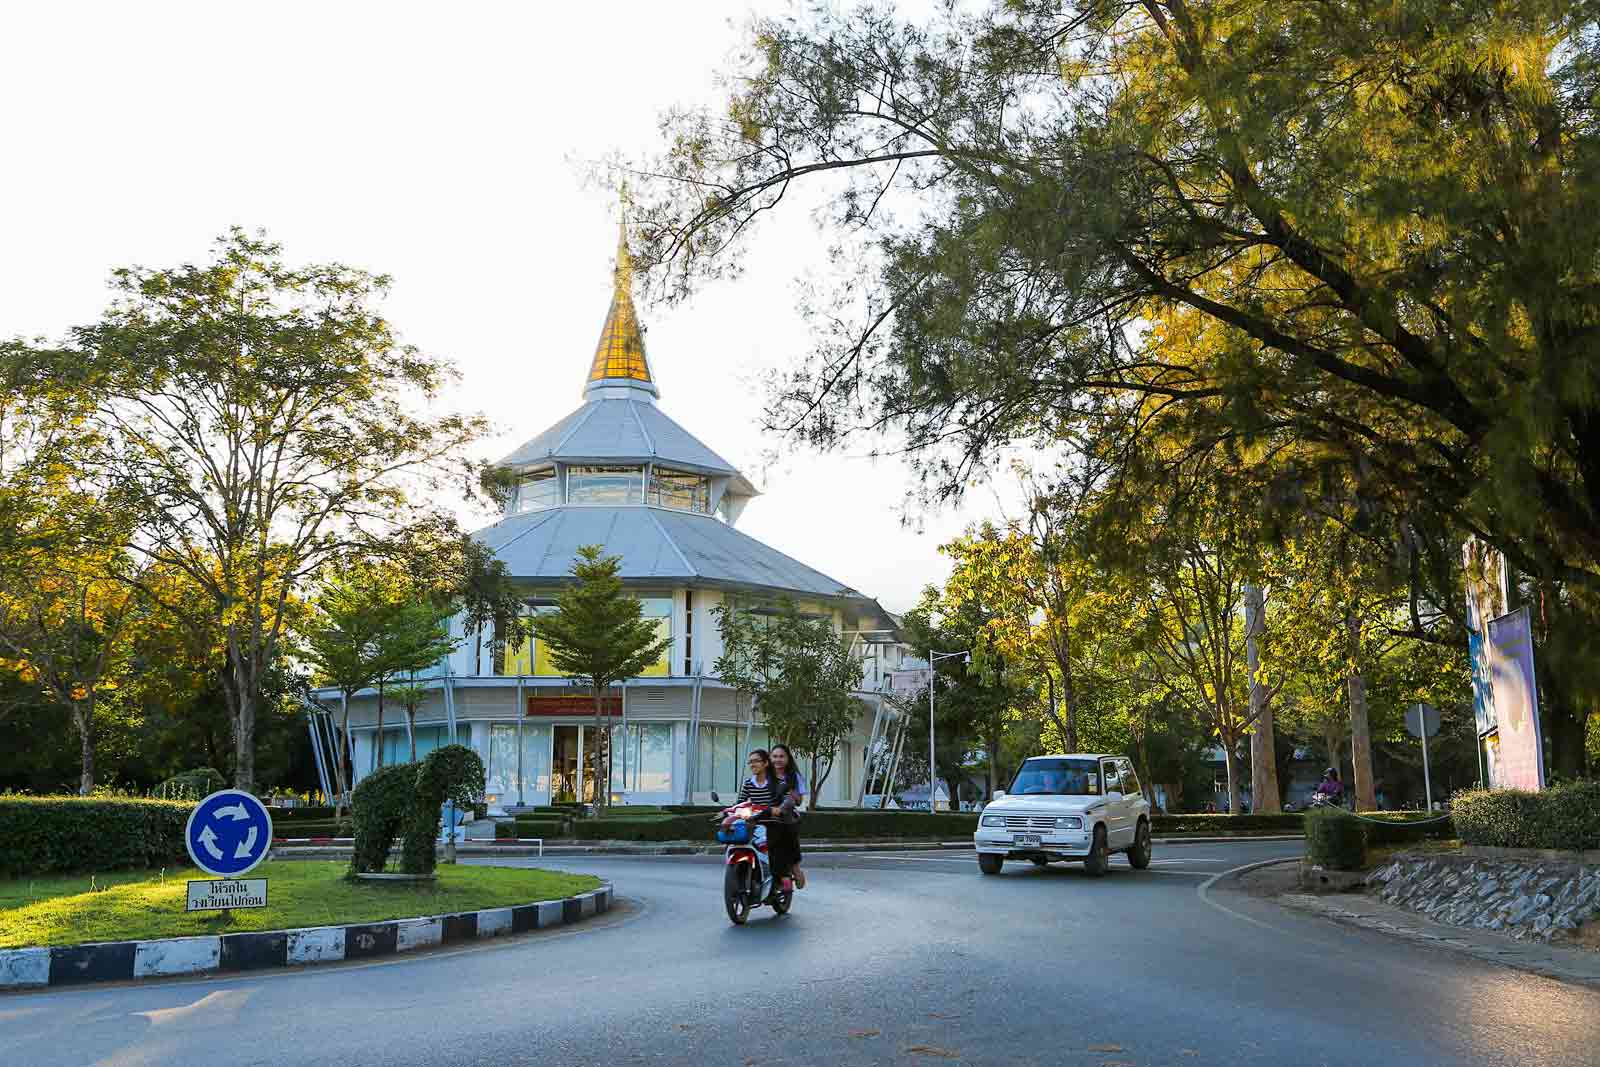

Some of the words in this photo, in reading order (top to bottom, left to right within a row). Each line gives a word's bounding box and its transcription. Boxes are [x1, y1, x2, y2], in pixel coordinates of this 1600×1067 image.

[191, 894, 263, 908] วงเวียนไปก่อน
